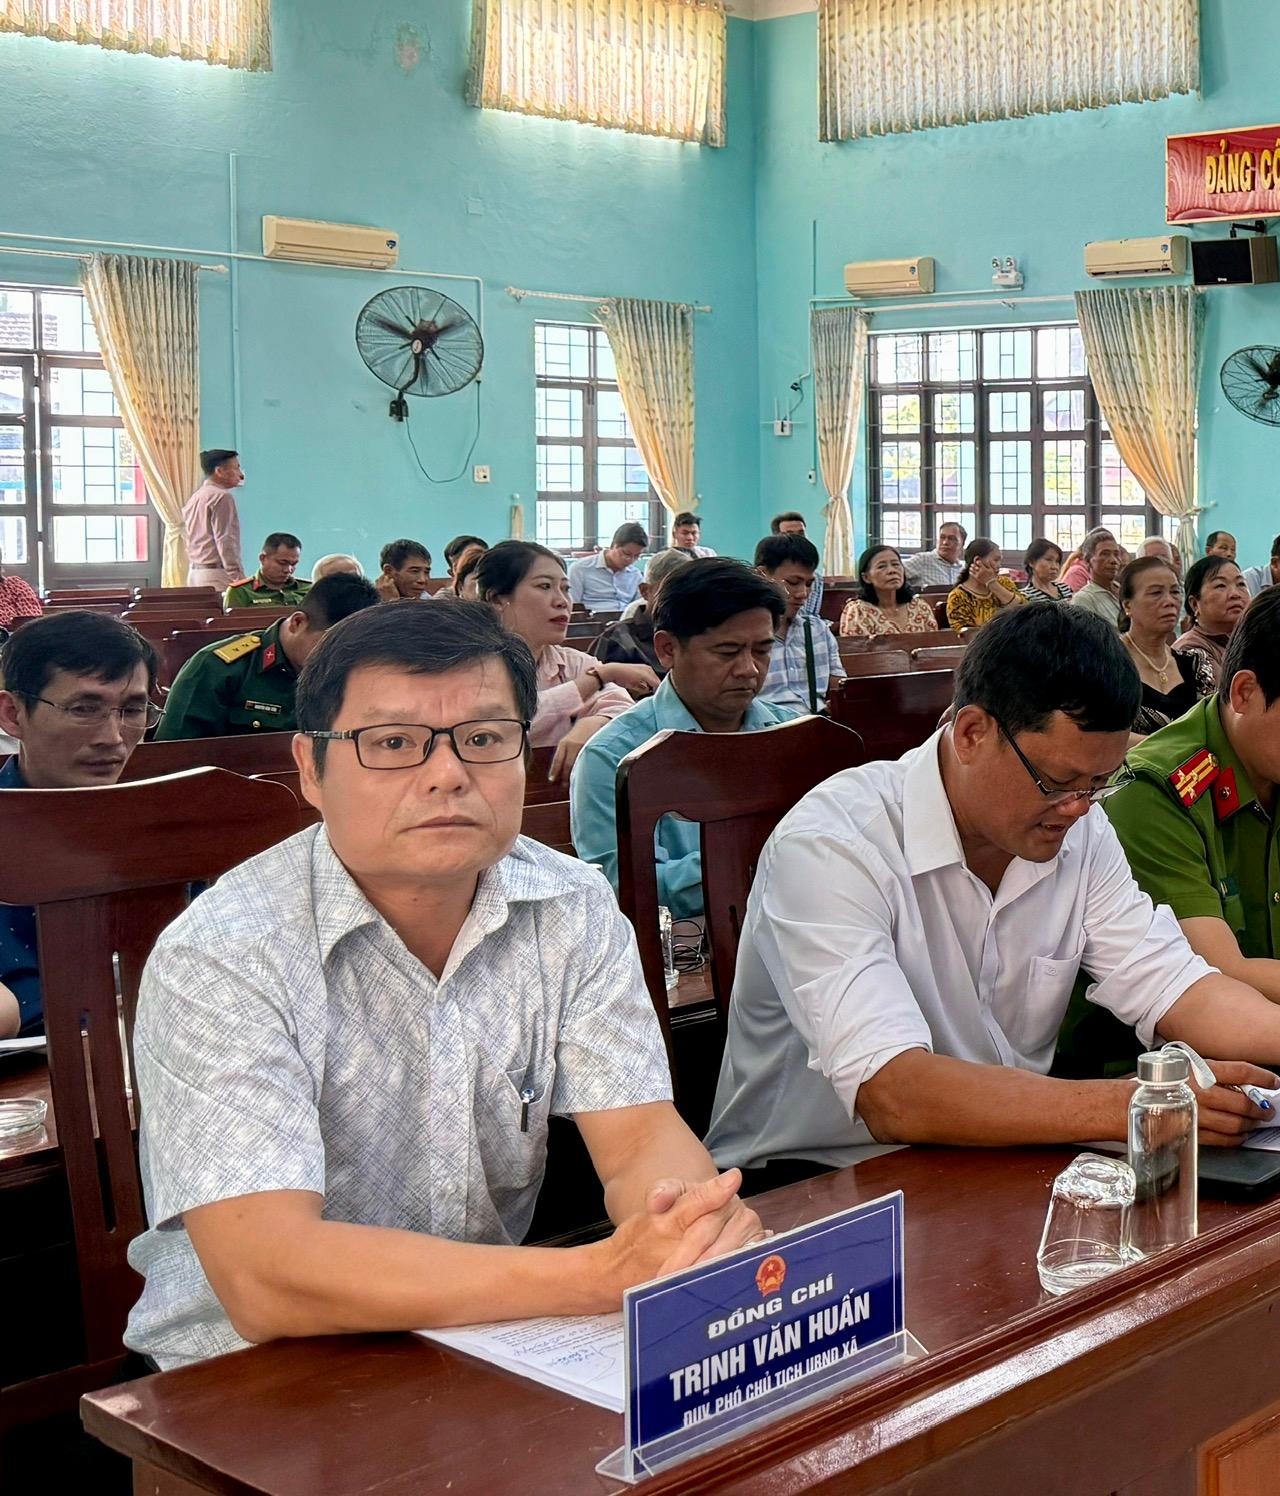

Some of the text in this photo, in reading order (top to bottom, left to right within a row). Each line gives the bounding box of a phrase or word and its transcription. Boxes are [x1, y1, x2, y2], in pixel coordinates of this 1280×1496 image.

[1205, 138, 1252, 194] ĐẢNG
[707, 1272, 834, 1340] ĐỒNG CHÍ
[669, 1287, 870, 1402] TRỊNH VĂN HUẤN
[715, 1385, 742, 1415] PHÓ
[745, 1370, 772, 1402] CHỦ
[842, 1334, 858, 1360] XÃ
